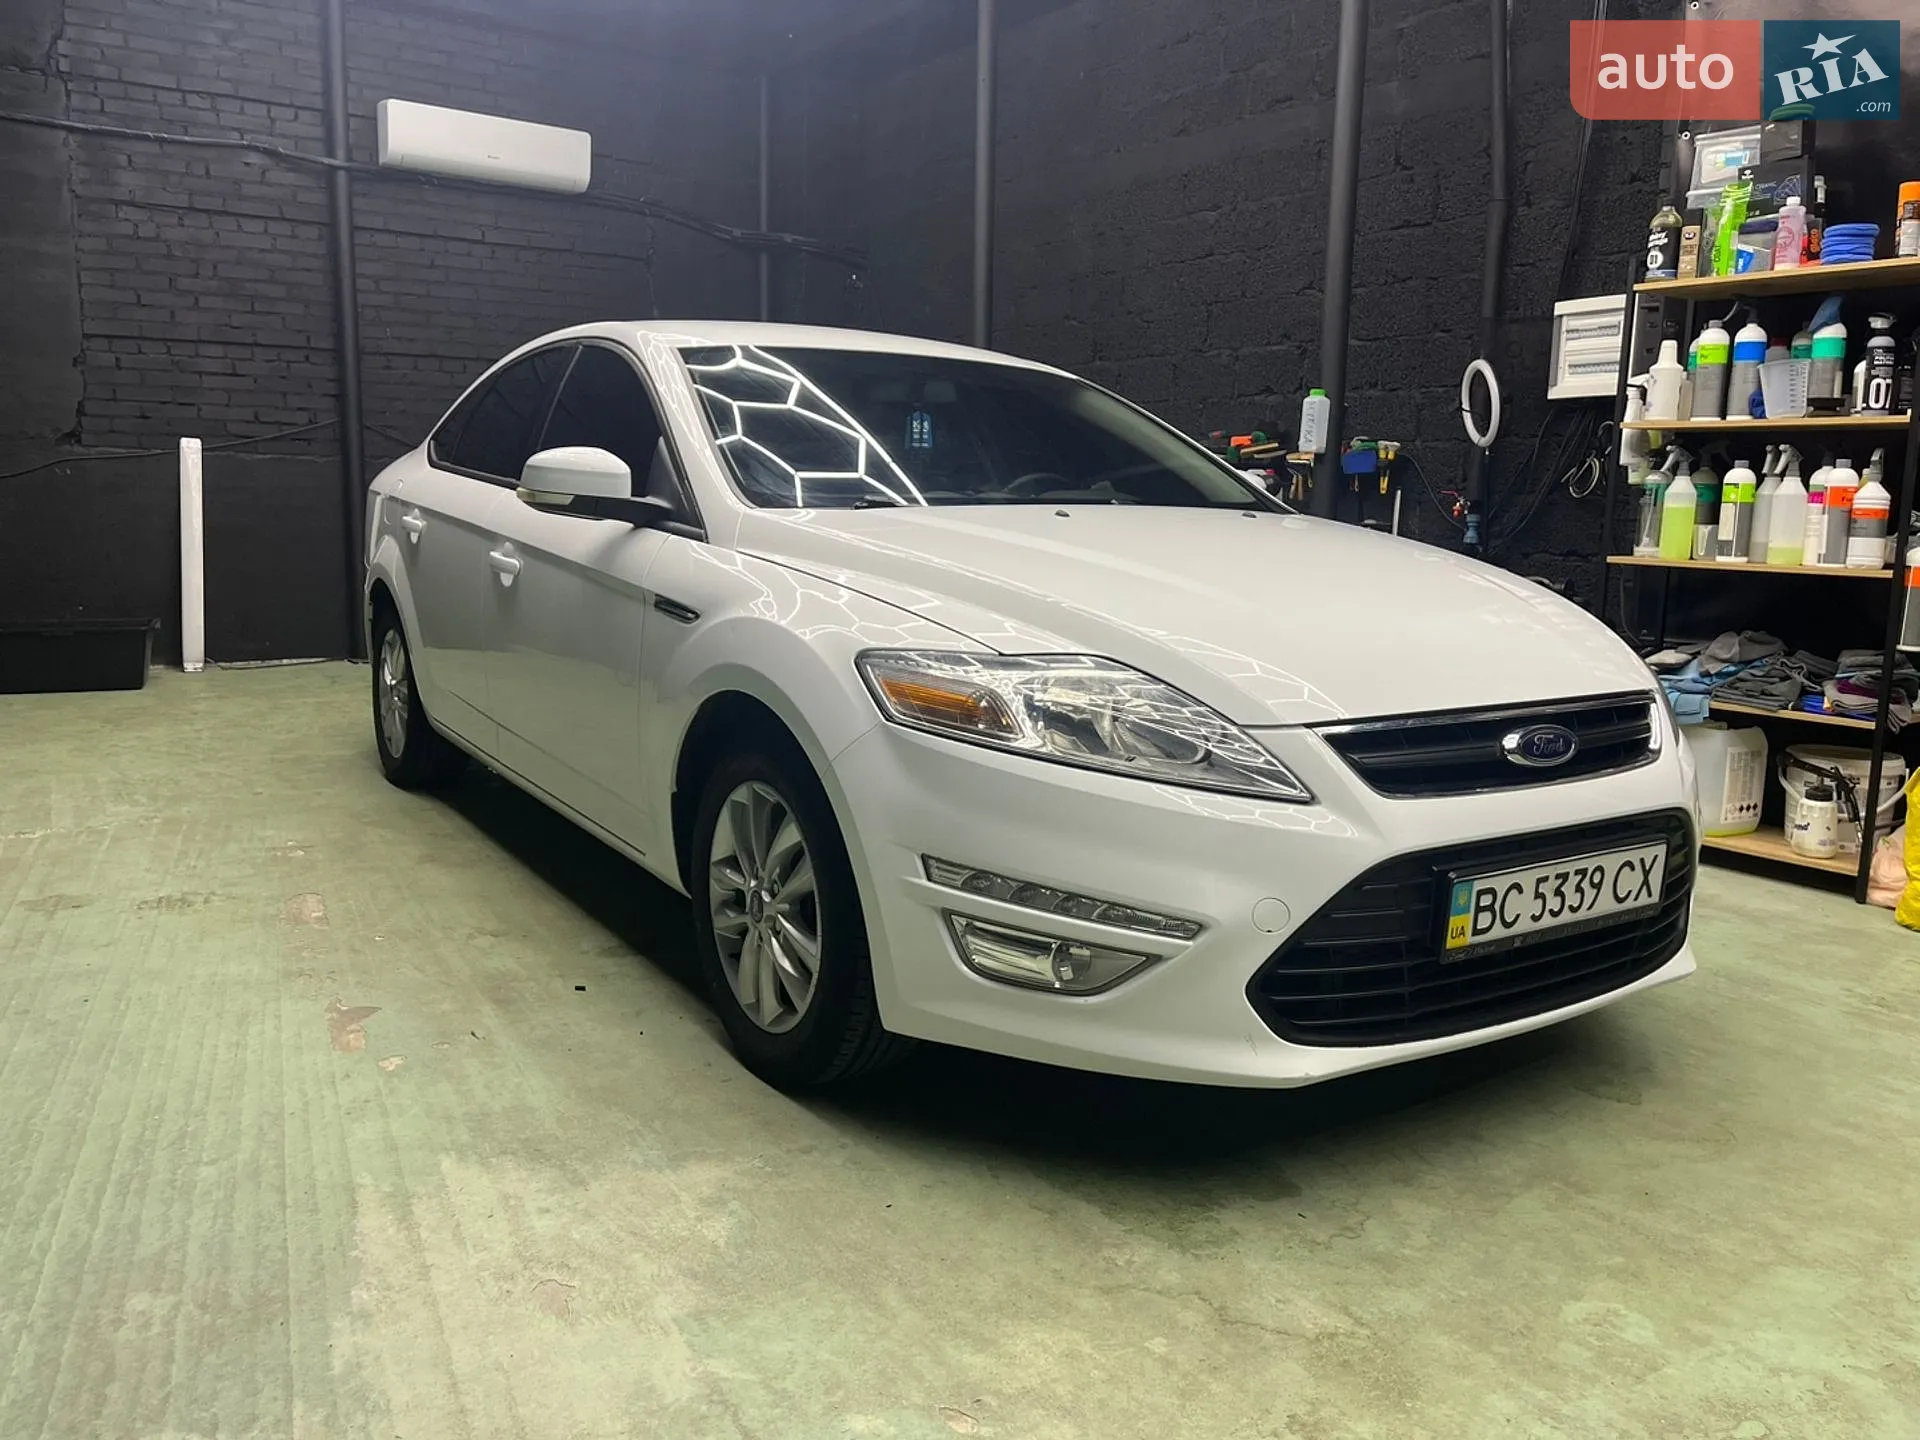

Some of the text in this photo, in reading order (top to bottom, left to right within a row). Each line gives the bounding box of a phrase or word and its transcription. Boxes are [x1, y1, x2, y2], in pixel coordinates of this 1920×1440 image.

[1533, 734, 1565, 755] Ford
[1470, 854, 1658, 937] BC 5339 CX
[1450, 925, 1466, 940] UA
